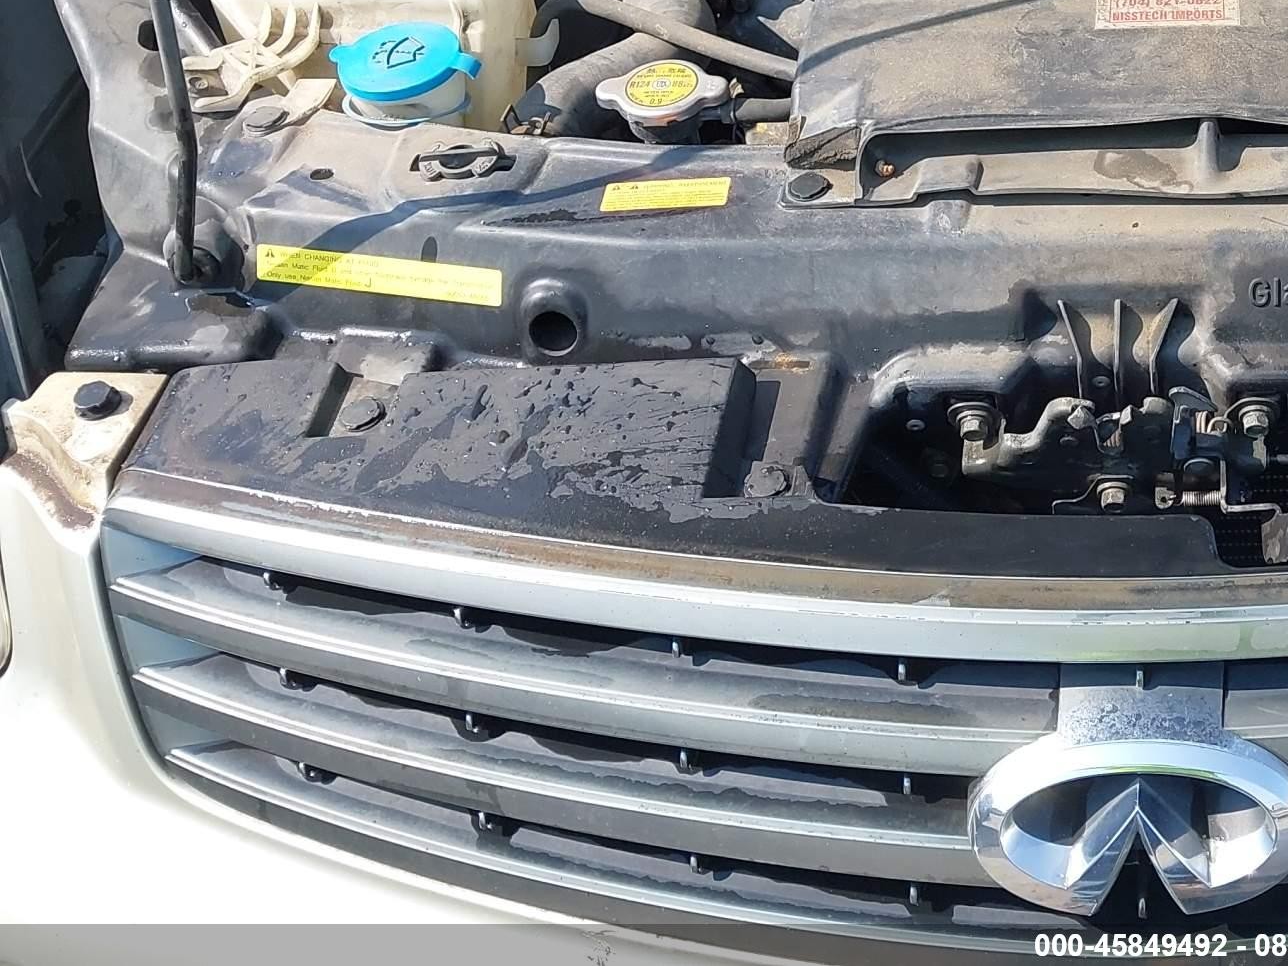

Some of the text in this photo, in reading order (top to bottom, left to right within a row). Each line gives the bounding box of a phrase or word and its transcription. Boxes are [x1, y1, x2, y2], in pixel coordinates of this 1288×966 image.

[1112, 9, 1223, 21] NISSTECH IMPORTS
[304, 253, 343, 263] CHANGING
[266, 271, 281, 280] Only
